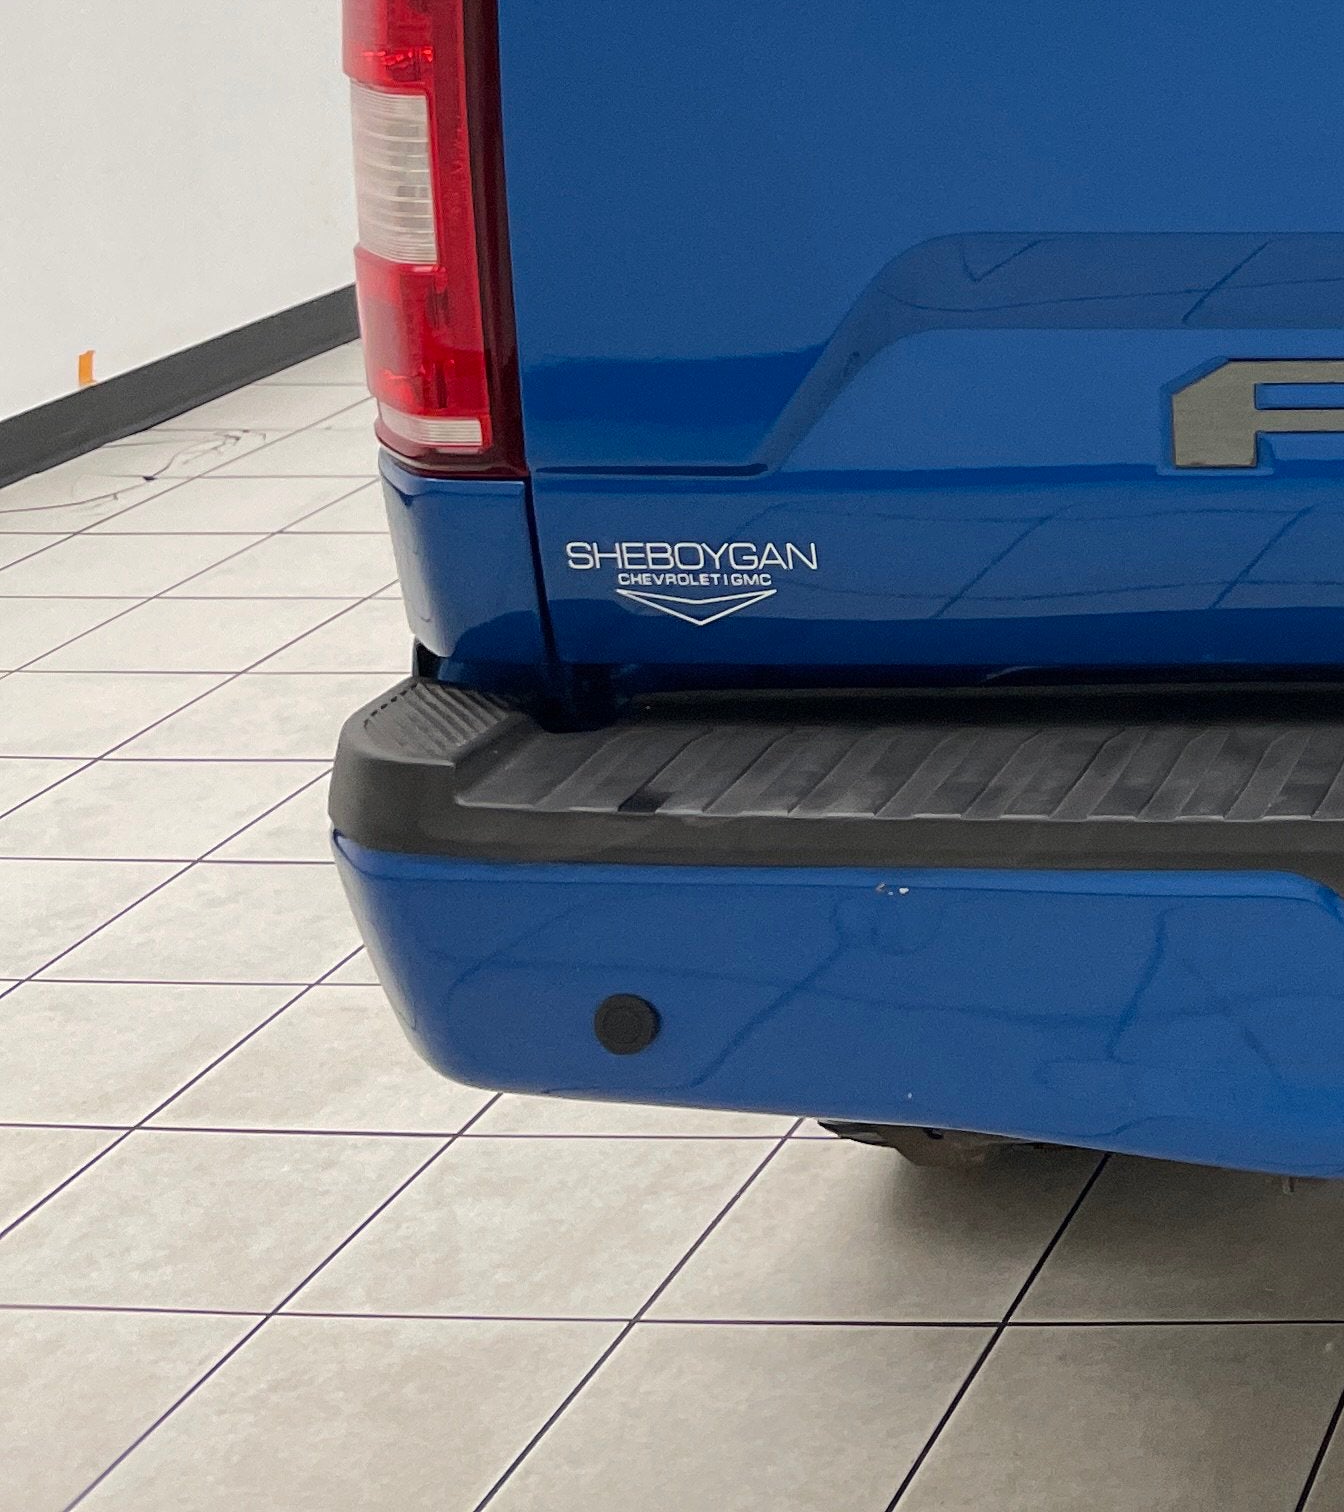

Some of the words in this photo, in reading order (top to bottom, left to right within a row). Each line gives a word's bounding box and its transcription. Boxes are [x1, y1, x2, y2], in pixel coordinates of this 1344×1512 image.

[565, 541, 818, 570] SHEBOYGAN
[617, 573, 723, 587] CHEVROLET
[730, 573, 773, 587] GMC
